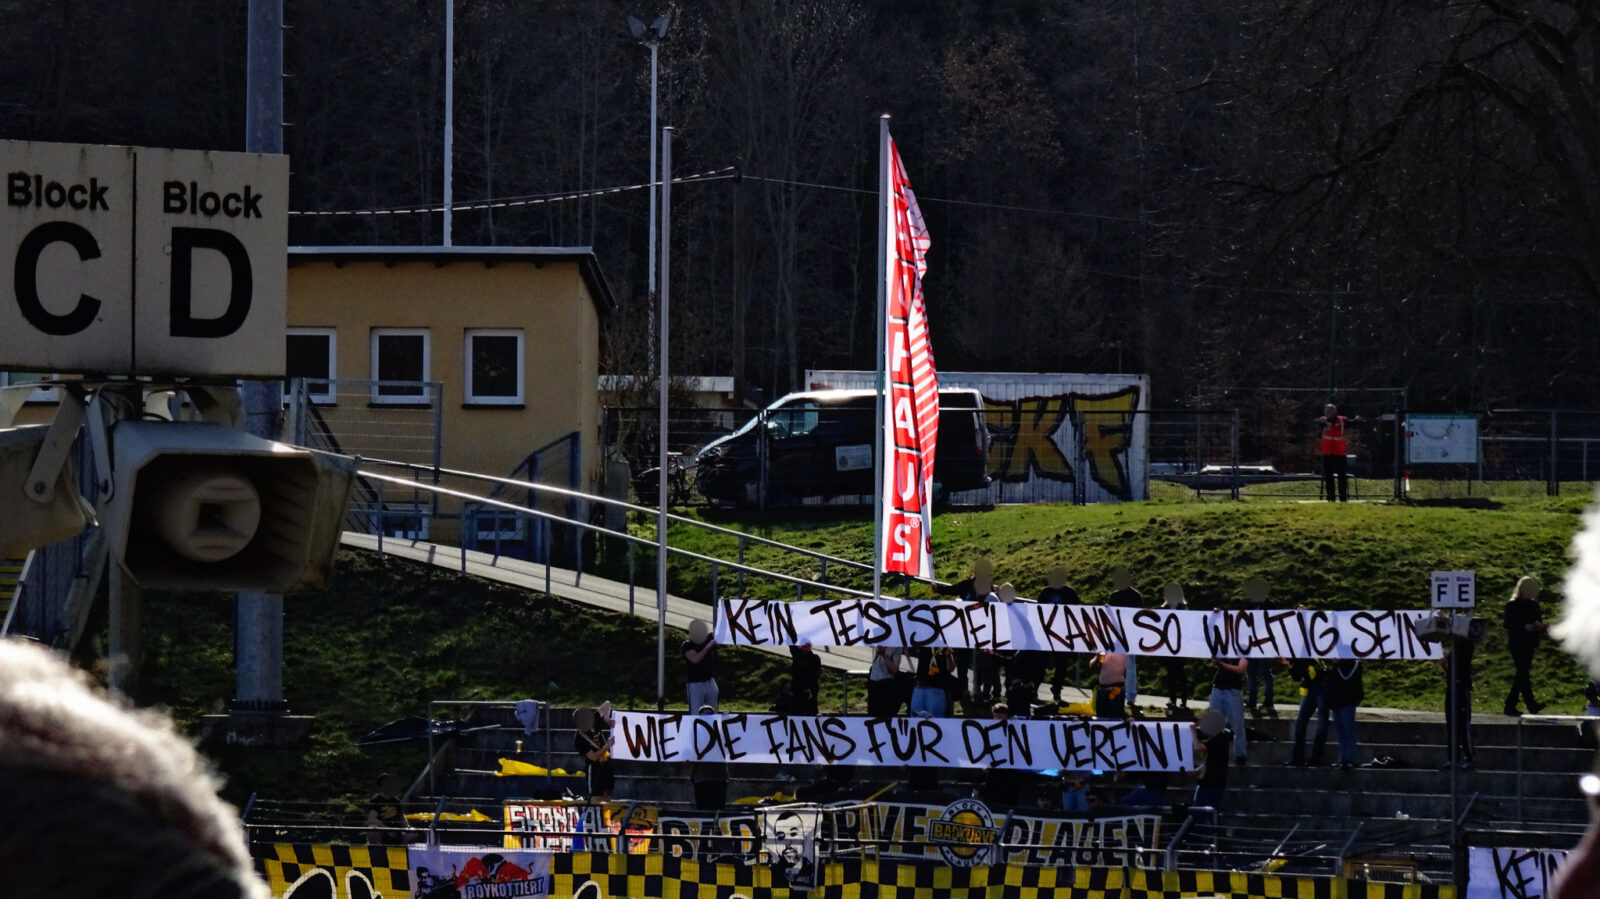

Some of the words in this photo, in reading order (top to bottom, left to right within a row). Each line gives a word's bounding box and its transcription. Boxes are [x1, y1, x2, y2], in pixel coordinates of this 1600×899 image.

[7, 172, 109, 211] Block
[163, 181, 263, 218] Block
[14, 221, 102, 336] C
[169, 226, 253, 339] D
[1437, 584, 1447, 602] F
[1458, 584, 1469, 602] E
[724, 599, 798, 646] KEIN
[810, 599, 1011, 648] TESTSPIEL
[1037, 604, 1130, 654] KANN
[1133, 609, 1181, 653] SO
[1203, 608, 1340, 658] WICHTIG
[1350, 610, 1432, 659] SEIN
[622, 714, 682, 763] WIE
[693, 714, 747, 761] DIE
[760, 714, 856, 765] FANS
[864, 716, 950, 763] FÜR
[962, 719, 1033, 768] DEN
[1050, 721, 1186, 773] VEREIN!
[1003, 816, 1154, 867] PLAUEN
[466, 878, 545, 899] BOYKOTTIERT
